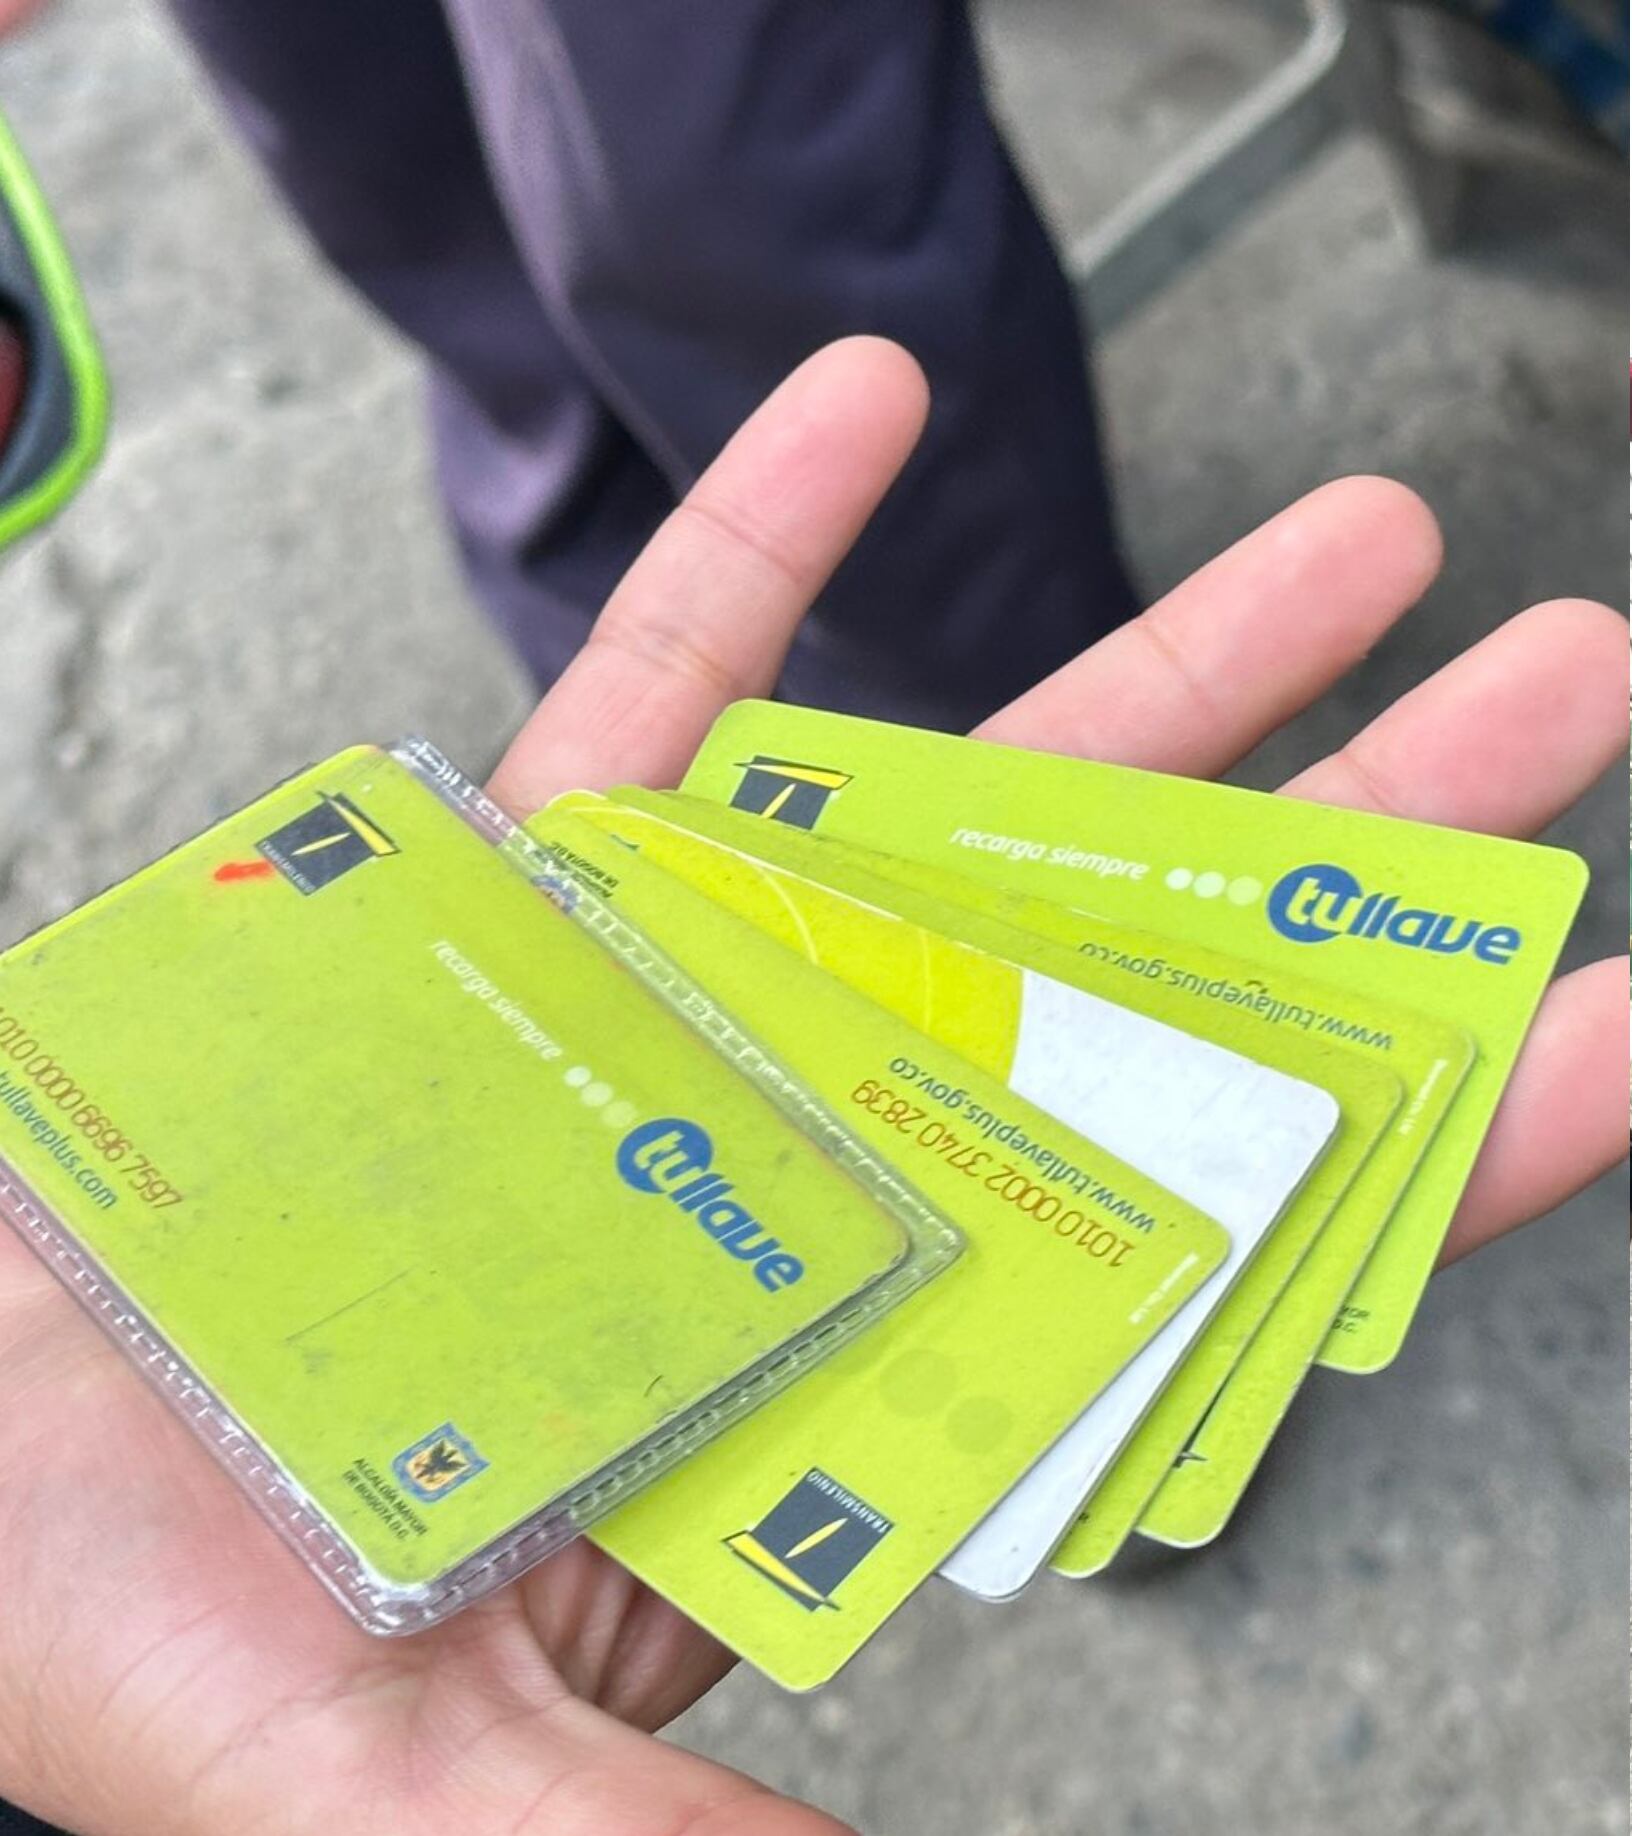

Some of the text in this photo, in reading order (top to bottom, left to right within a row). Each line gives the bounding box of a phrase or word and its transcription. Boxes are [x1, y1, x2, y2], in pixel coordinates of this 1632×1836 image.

[949, 826, 1149, 882] recarga siempre
[1266, 863, 1521, 966] tullave
[429, 939, 564, 1062] recarga siempre
[0, 1006, 184, 1209] 010 0000 6696 7597
[850, 1079, 1136, 1268] 1010 0002 3740 2839
[889, 1057, 1157, 1235] www.tullaveplus.gov.co
[616, 1117, 805, 1293] tullave
[806, 1470, 890, 1533] TRANSMILENIO
